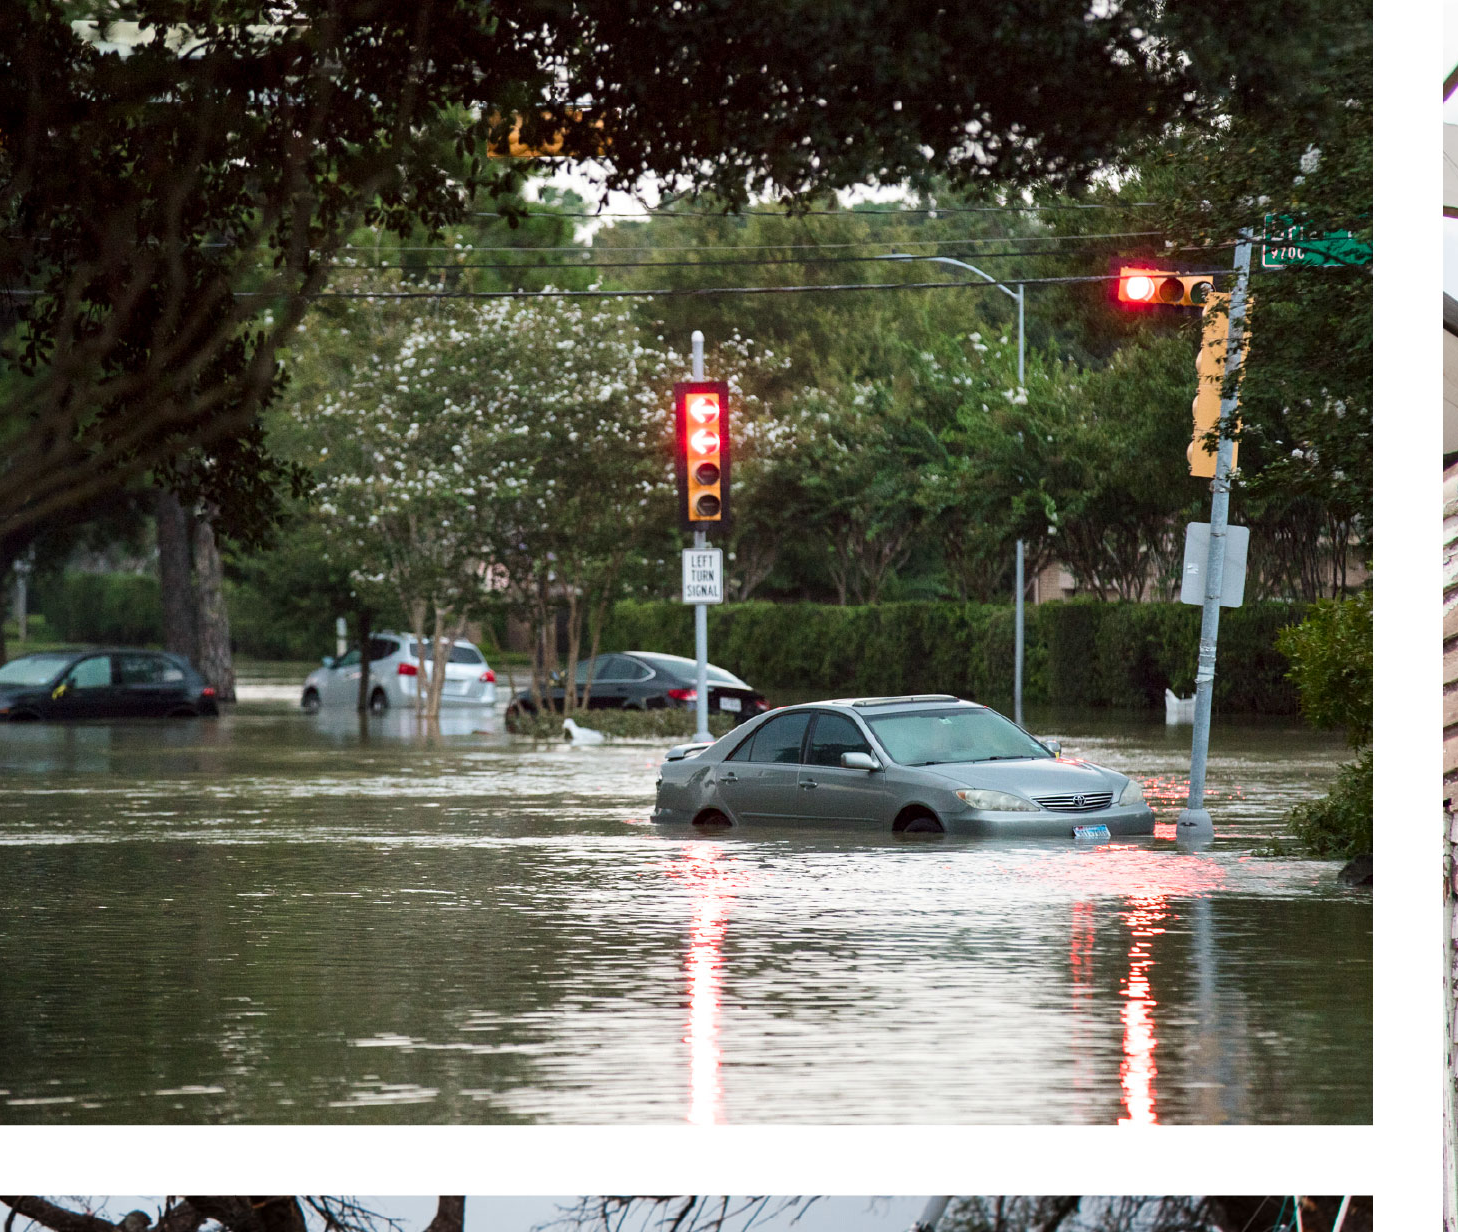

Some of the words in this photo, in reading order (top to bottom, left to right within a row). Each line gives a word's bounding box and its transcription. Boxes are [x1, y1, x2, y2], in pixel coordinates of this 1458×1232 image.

[691, 555, 712, 568] LEFT
[691, 569, 714, 582] TURN
[687, 584, 719, 597] SIGNAL
